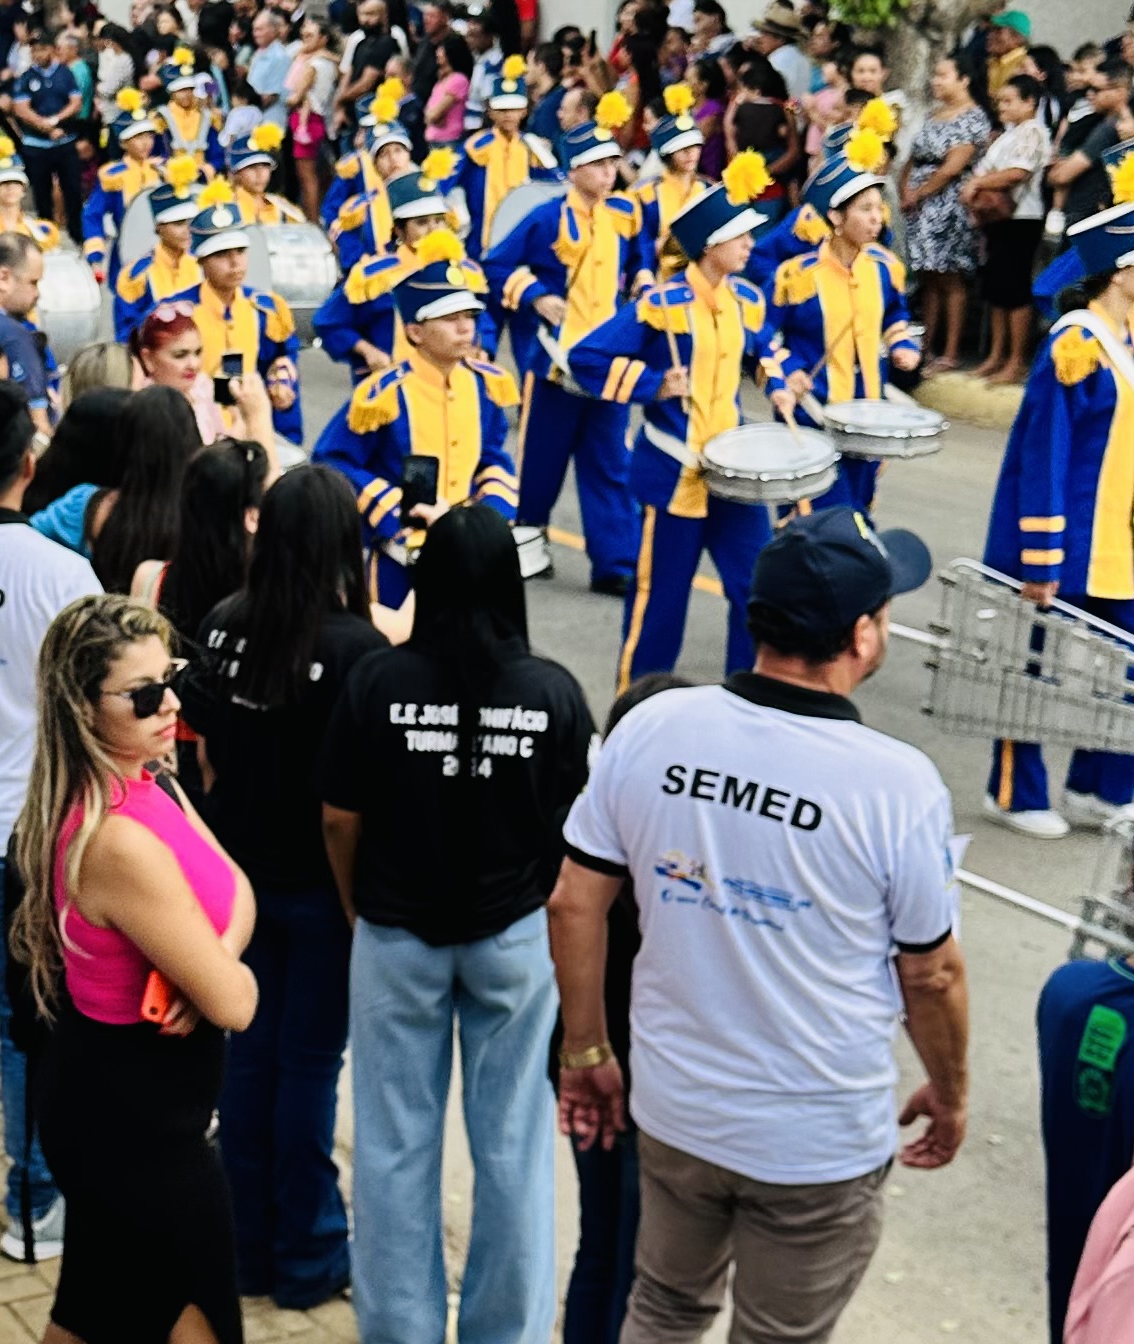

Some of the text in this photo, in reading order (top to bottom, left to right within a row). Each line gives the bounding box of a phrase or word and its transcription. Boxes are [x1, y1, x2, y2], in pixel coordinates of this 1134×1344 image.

[519, 736, 534, 758] C
[442, 754, 492, 778] 24
[661, 764, 823, 832] SEMED
